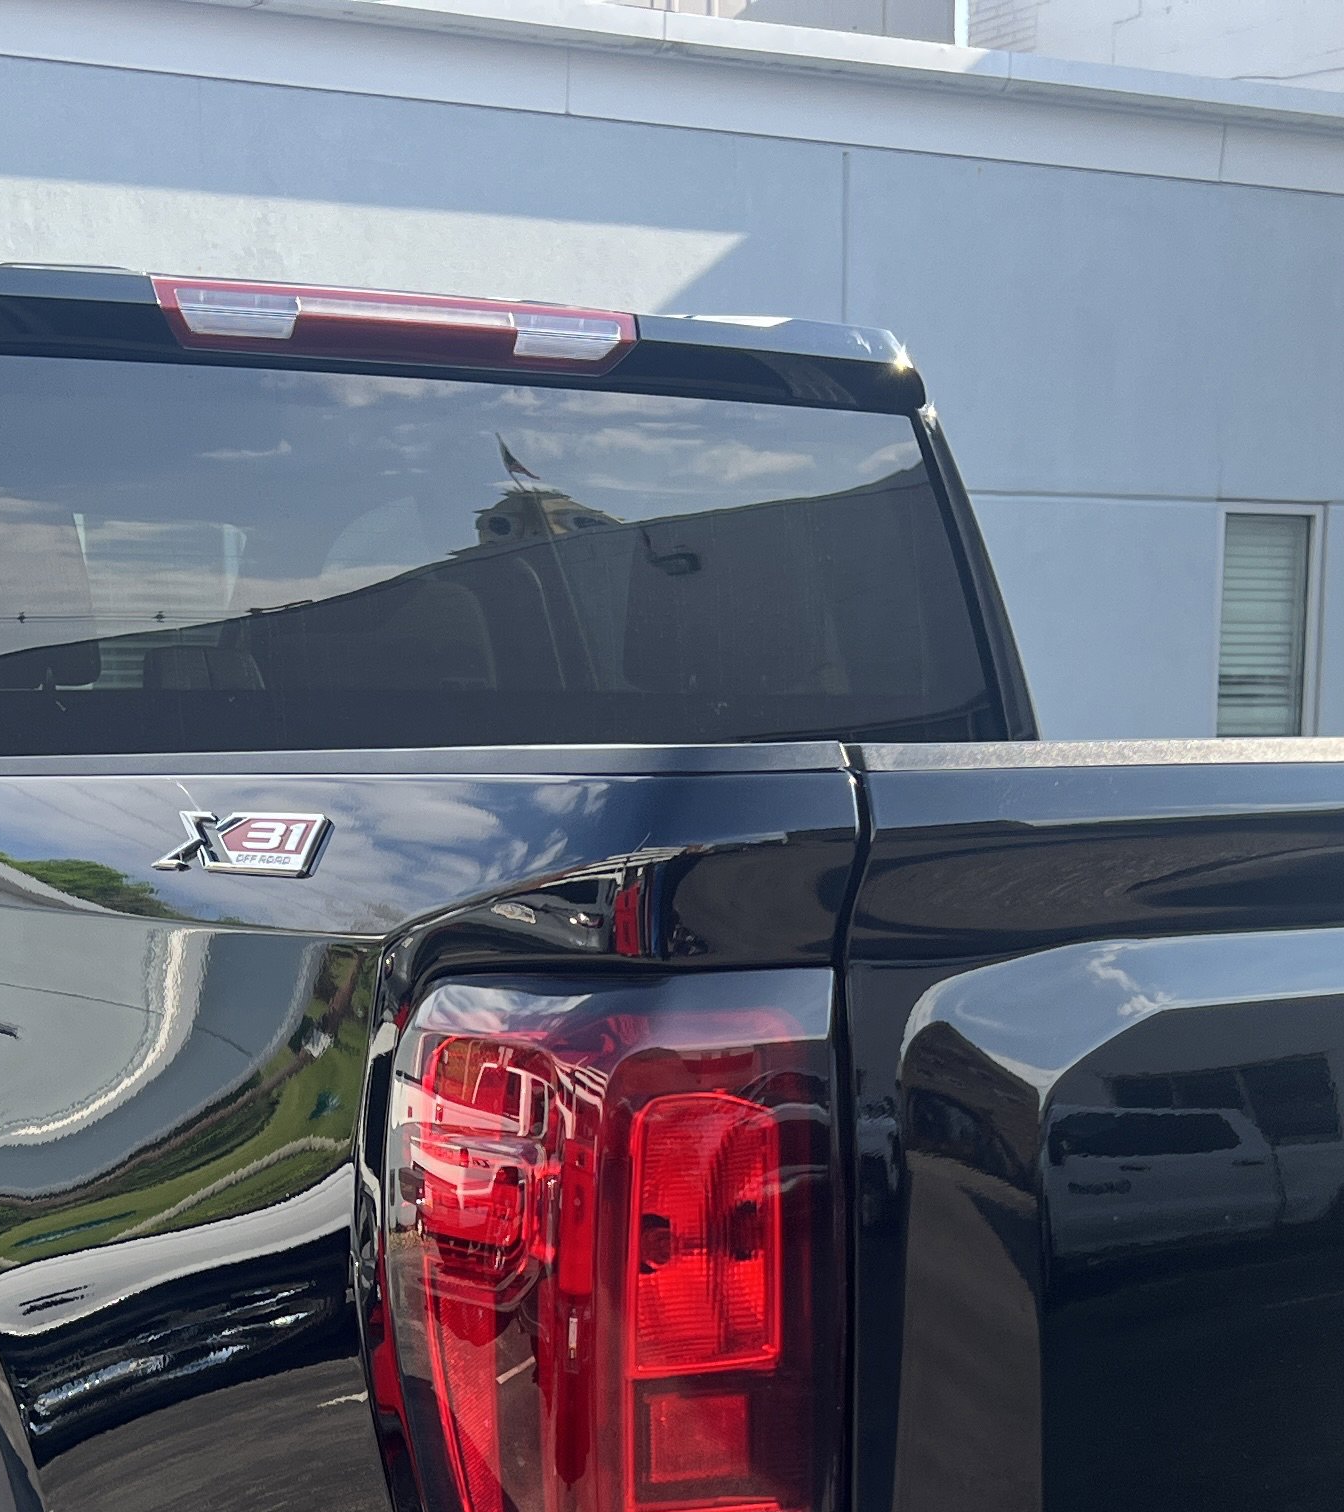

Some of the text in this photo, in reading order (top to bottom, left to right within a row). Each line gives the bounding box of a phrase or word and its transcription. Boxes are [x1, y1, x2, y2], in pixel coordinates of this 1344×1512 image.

[152, 811, 312, 872] X31
[235, 853, 291, 865] OFF ROAD
